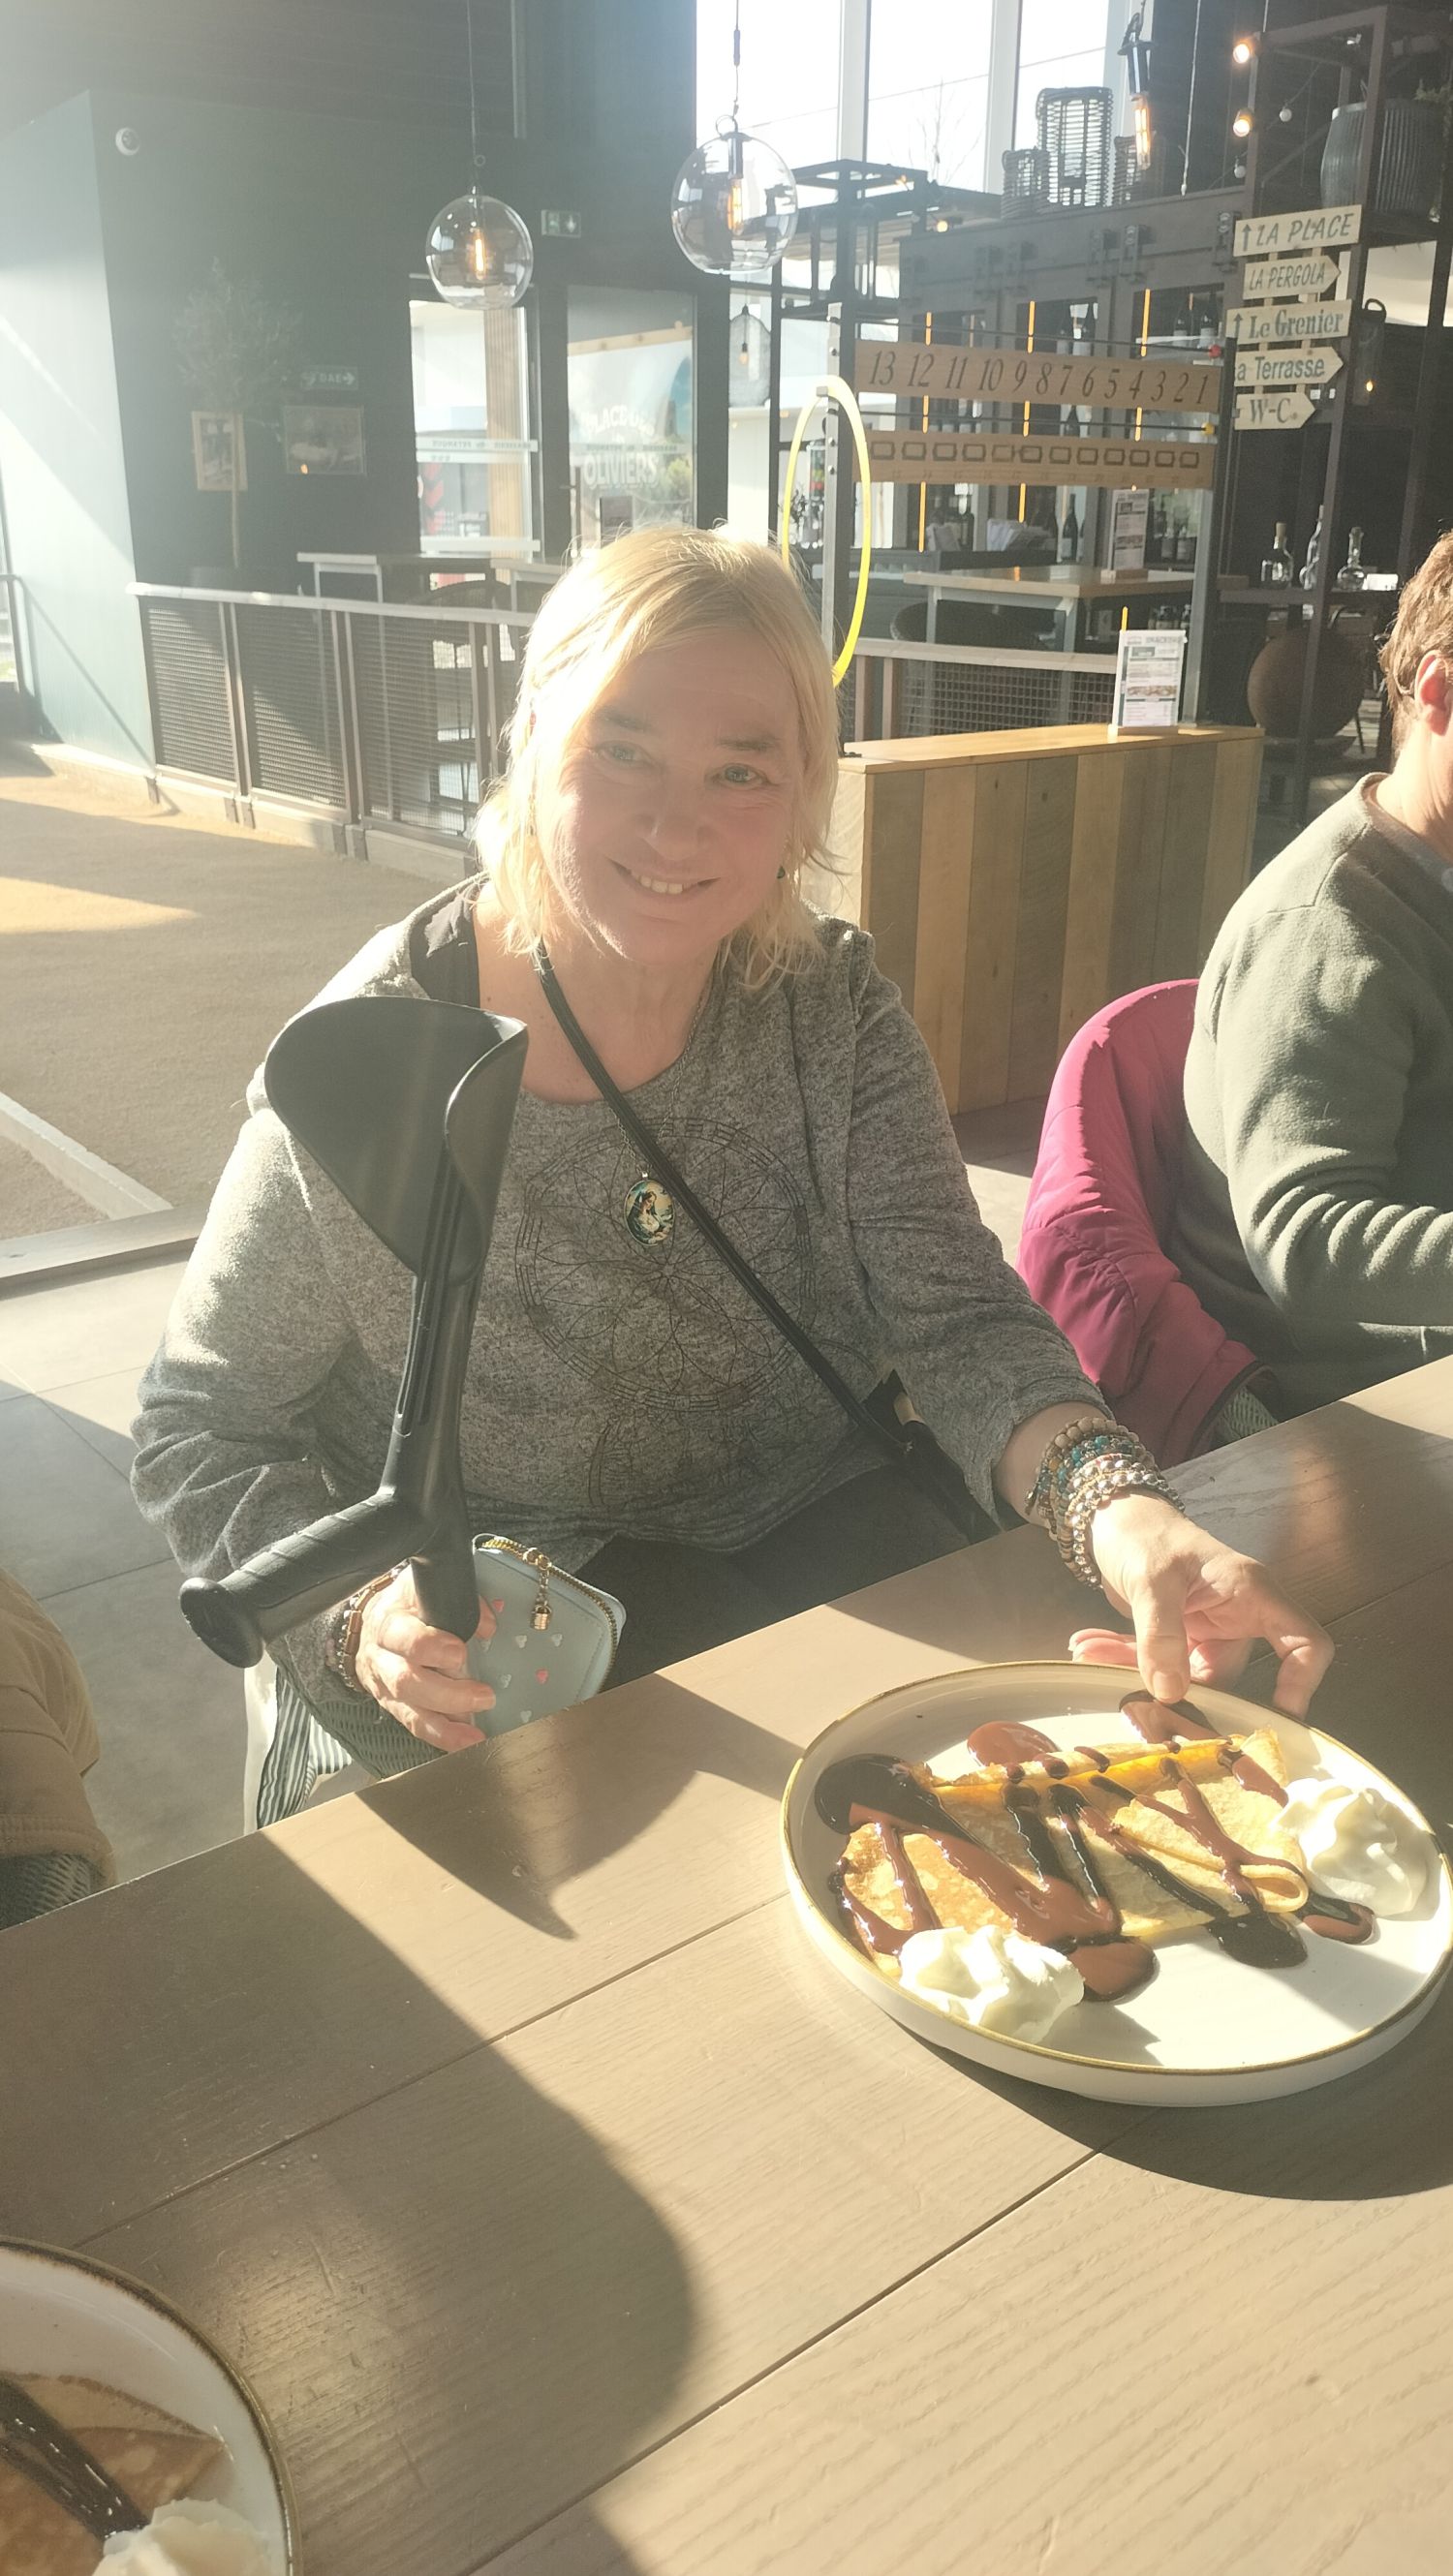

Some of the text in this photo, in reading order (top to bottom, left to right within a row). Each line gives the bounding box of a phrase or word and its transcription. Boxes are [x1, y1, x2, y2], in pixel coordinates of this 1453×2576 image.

[1256, 213, 1354, 246] LA PLACE
[1250, 261, 1325, 291] LA PERGOLA
[1249, 309, 1344, 339] Le Grenier
[869, 350, 1209, 404] 13 12 11 10 9 8 7 6 5 4 3 2 1
[1255, 356, 1325, 381] Terrasse
[583, 451, 659, 486] OLIVIERS
